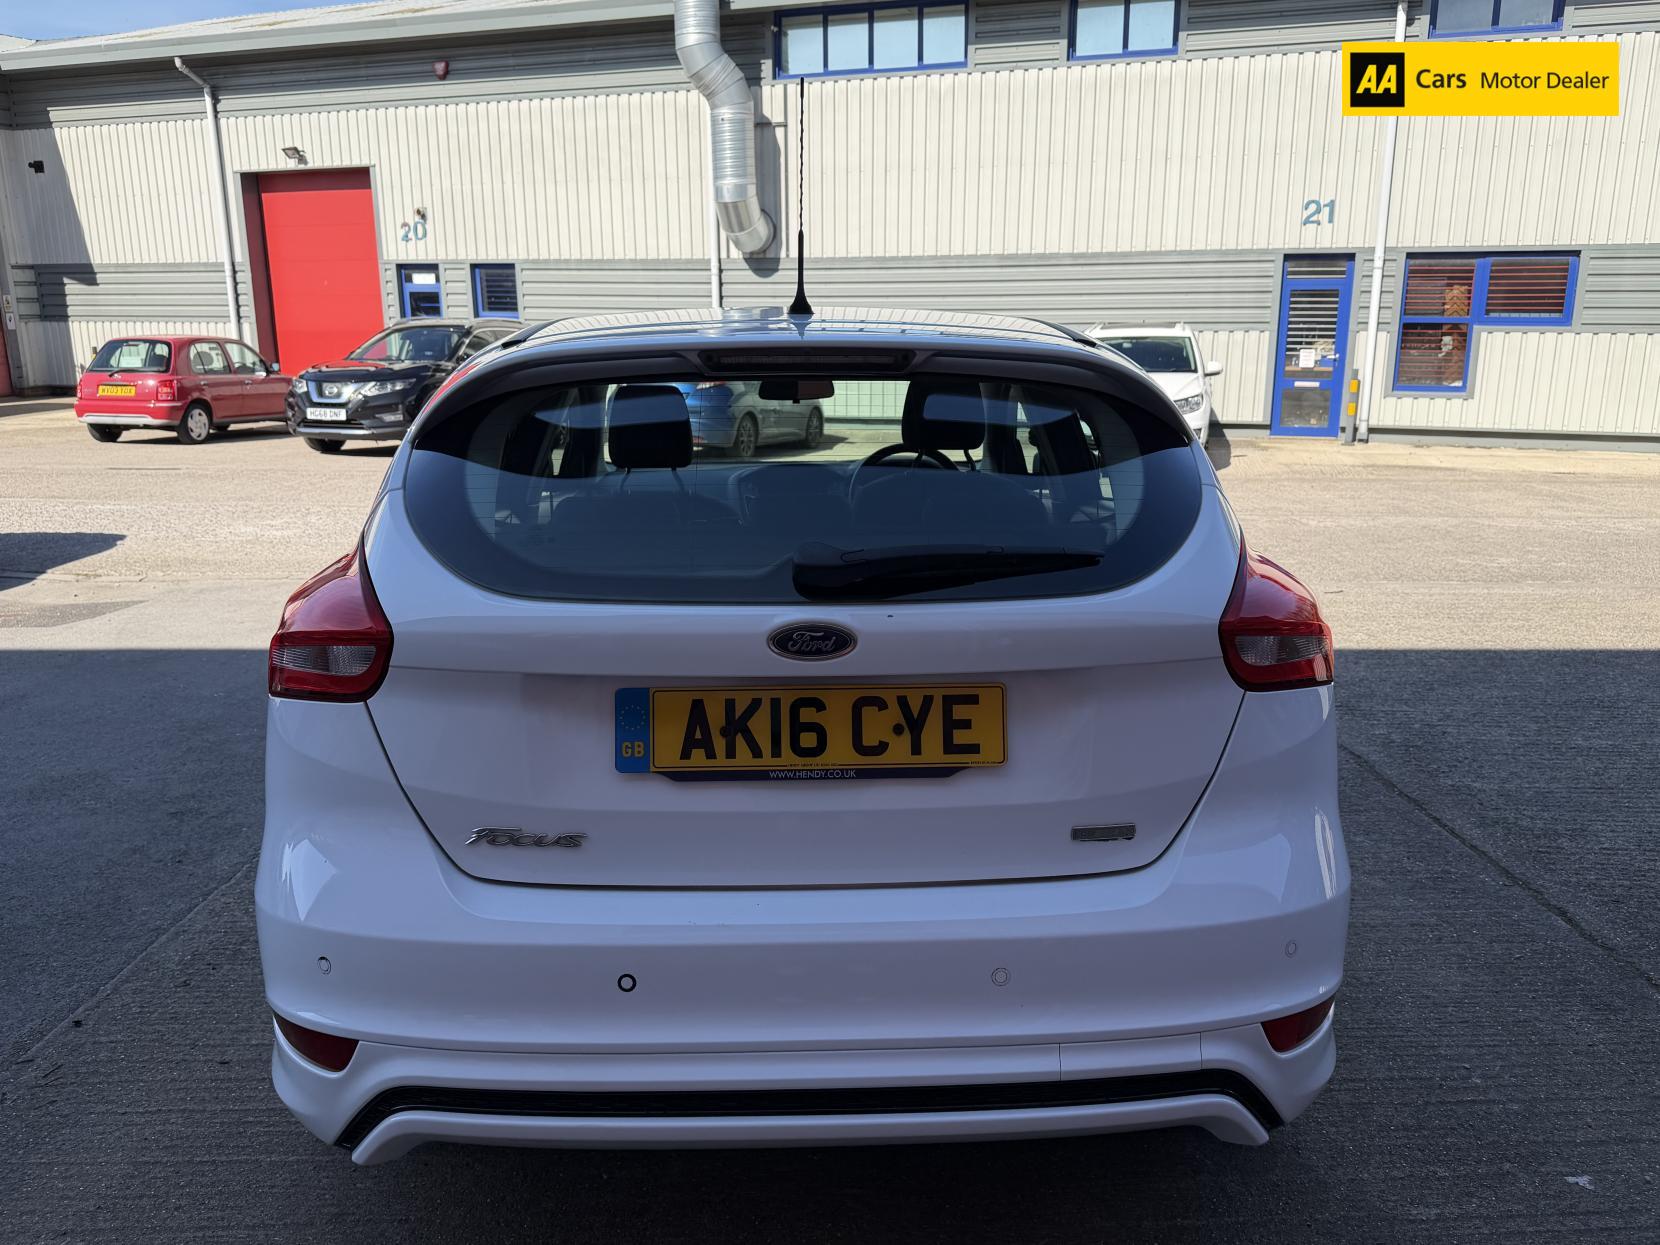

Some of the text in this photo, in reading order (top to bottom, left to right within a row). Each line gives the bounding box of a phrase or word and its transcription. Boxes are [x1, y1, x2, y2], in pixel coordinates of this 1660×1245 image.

[1302, 199, 1336, 226] 21
[400, 220, 428, 242] 20
[788, 631, 836, 652] Ford
[679, 694, 981, 761] AK16 CYE
[621, 741, 645, 758] GB
[768, 770, 857, 780] WWW.HENDY.CO.UK
